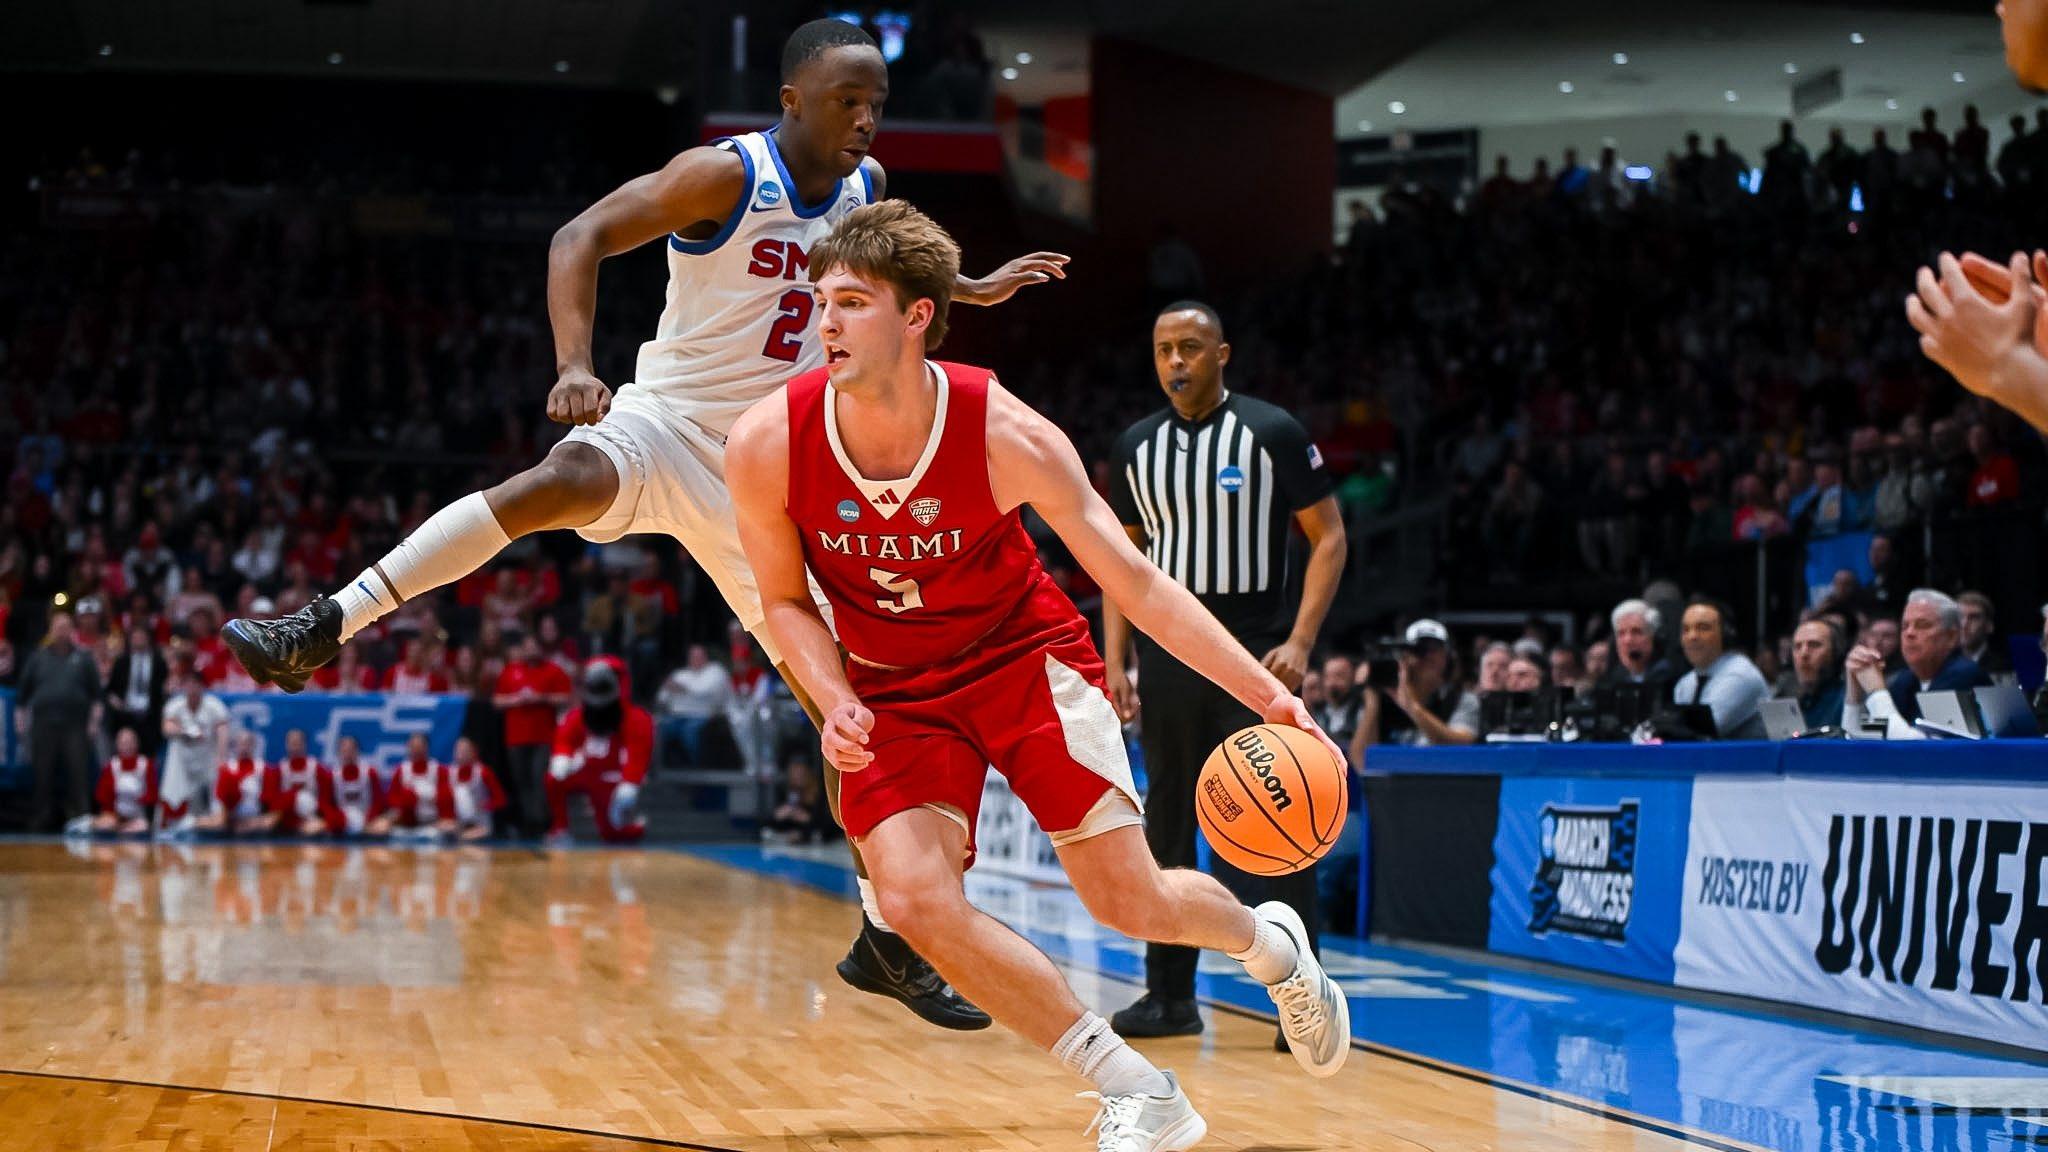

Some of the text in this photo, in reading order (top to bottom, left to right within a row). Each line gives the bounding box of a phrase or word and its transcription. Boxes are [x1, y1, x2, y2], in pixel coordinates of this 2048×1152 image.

[762, 289, 815, 363] 2
[911, 505, 940, 517] MAC
[817, 529, 962, 561] MIAMI
[868, 566, 924, 614] 5
[1233, 730, 1293, 813] Wilson
[1553, 815, 1611, 868] MARCH
[1557, 869, 1633, 924] MADNESS
[1699, 856, 1775, 912] HOSTED
[1775, 861, 1809, 915] BY
